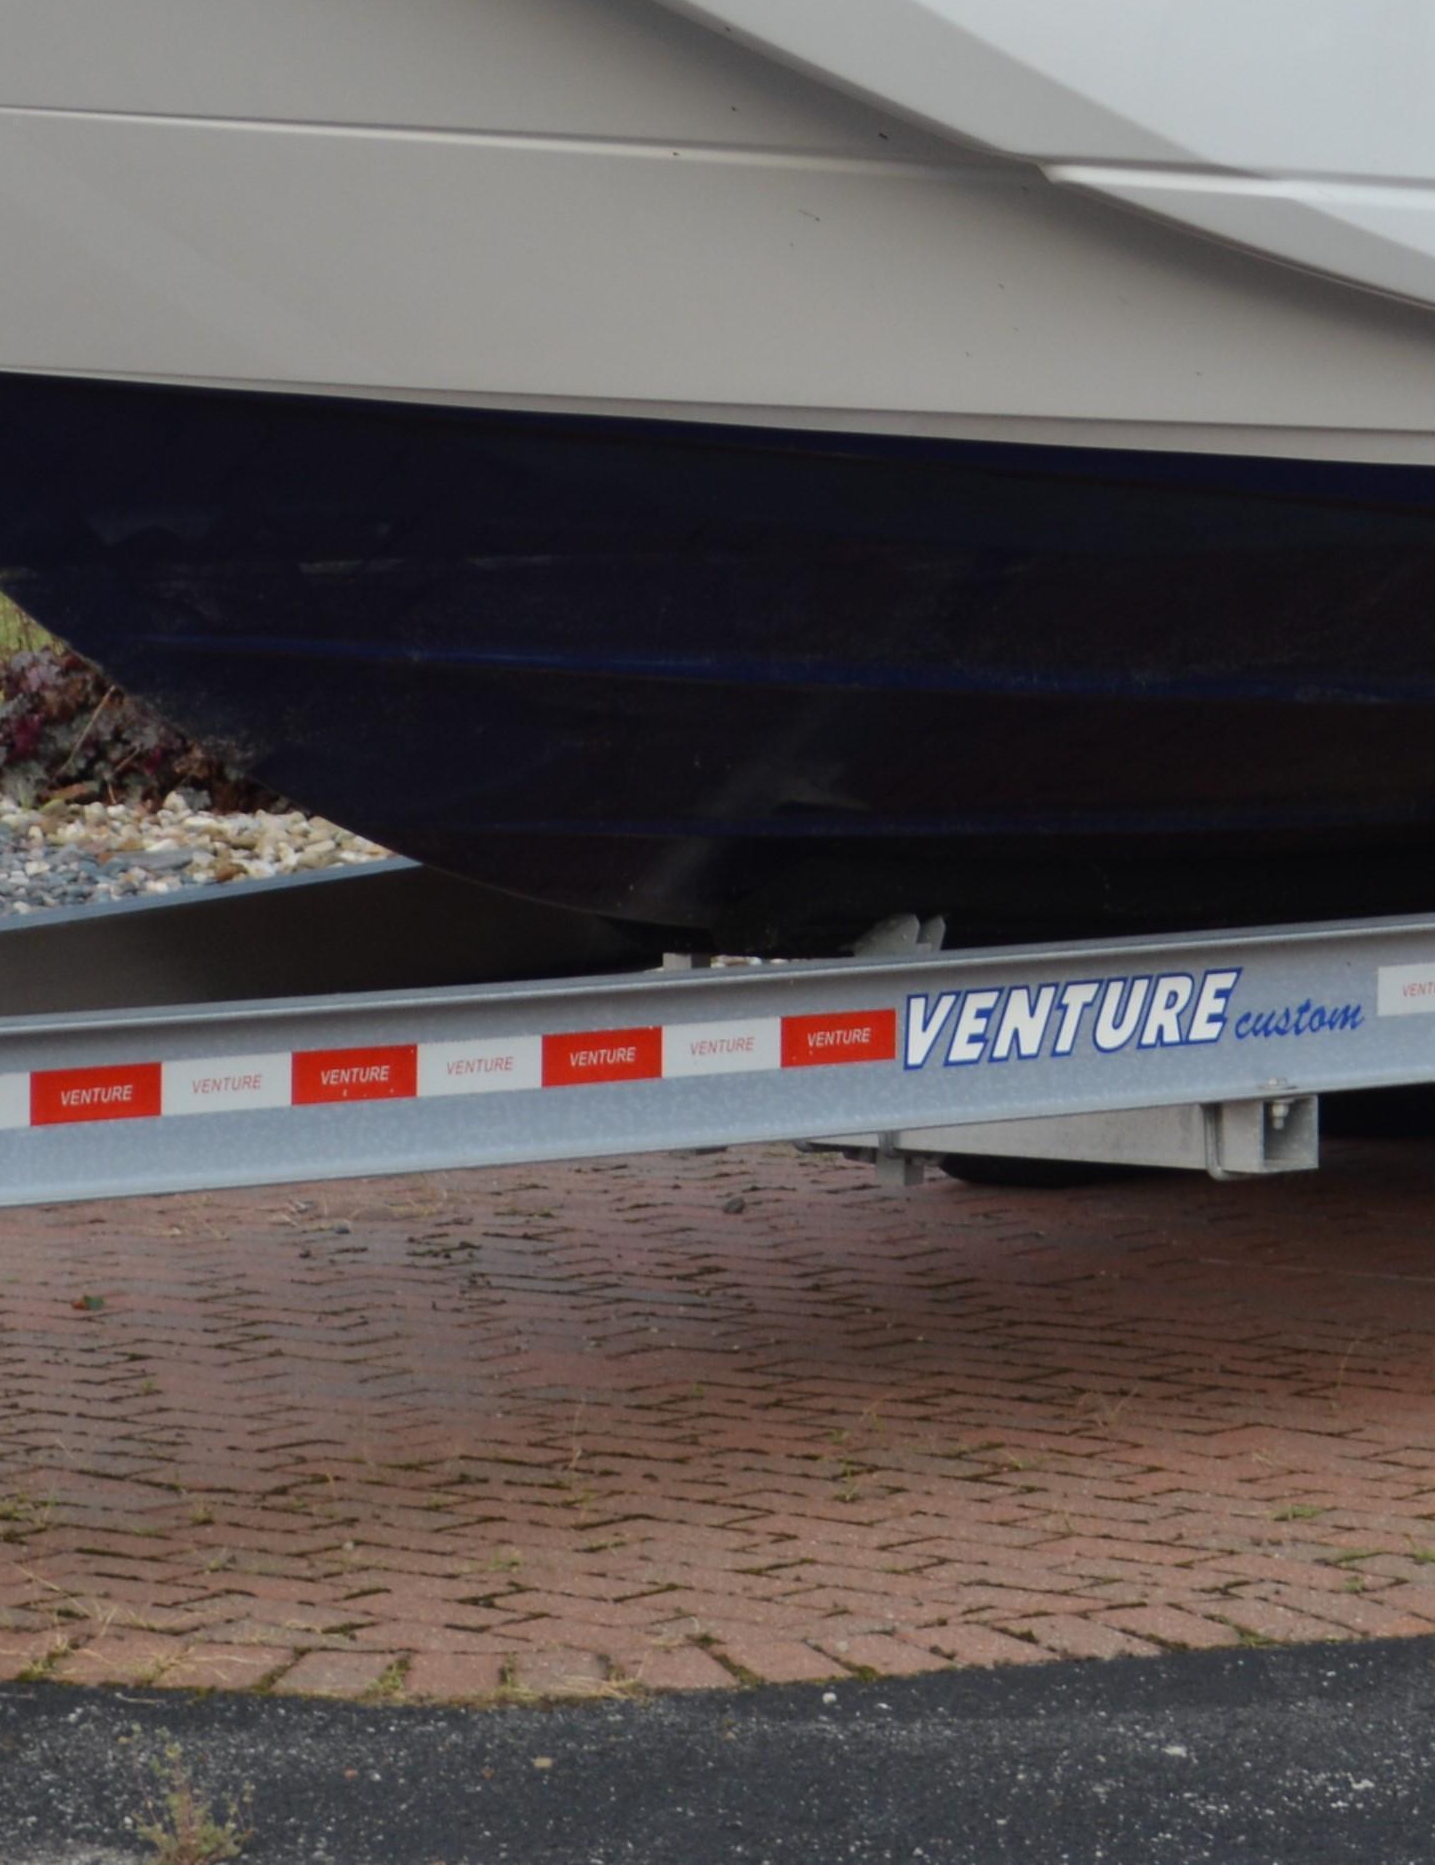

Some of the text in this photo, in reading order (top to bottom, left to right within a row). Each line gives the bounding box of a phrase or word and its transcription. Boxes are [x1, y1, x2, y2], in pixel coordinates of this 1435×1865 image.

[904, 967, 1364, 1070] VENTURE custom
[61, 1085, 133, 1106] VENTURE
[192, 1074, 262, 1094] VENTURE
[320, 1065, 389, 1085] VENTURE
[446, 1056, 513, 1075] VENTURE
[569, 1046, 636, 1067] VENTURE
[690, 1037, 755, 1056] VENTURE
[807, 1028, 871, 1047] VENTURE
